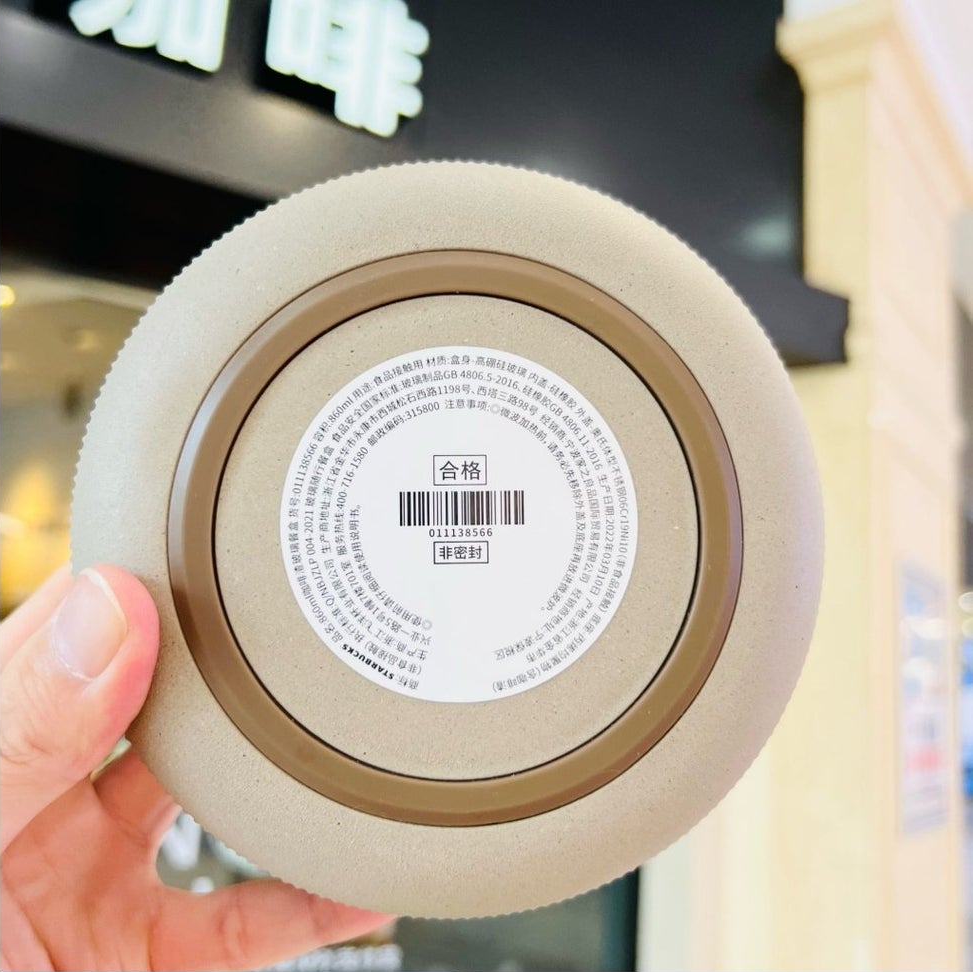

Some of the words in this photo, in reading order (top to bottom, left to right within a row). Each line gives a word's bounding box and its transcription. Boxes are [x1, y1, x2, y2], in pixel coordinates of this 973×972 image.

[439, 460, 481, 481] 合格
[428, 528, 493, 538] 011138566
[439, 545, 483, 560] 非密封
[340, 640, 396, 680] STARBUCKS
